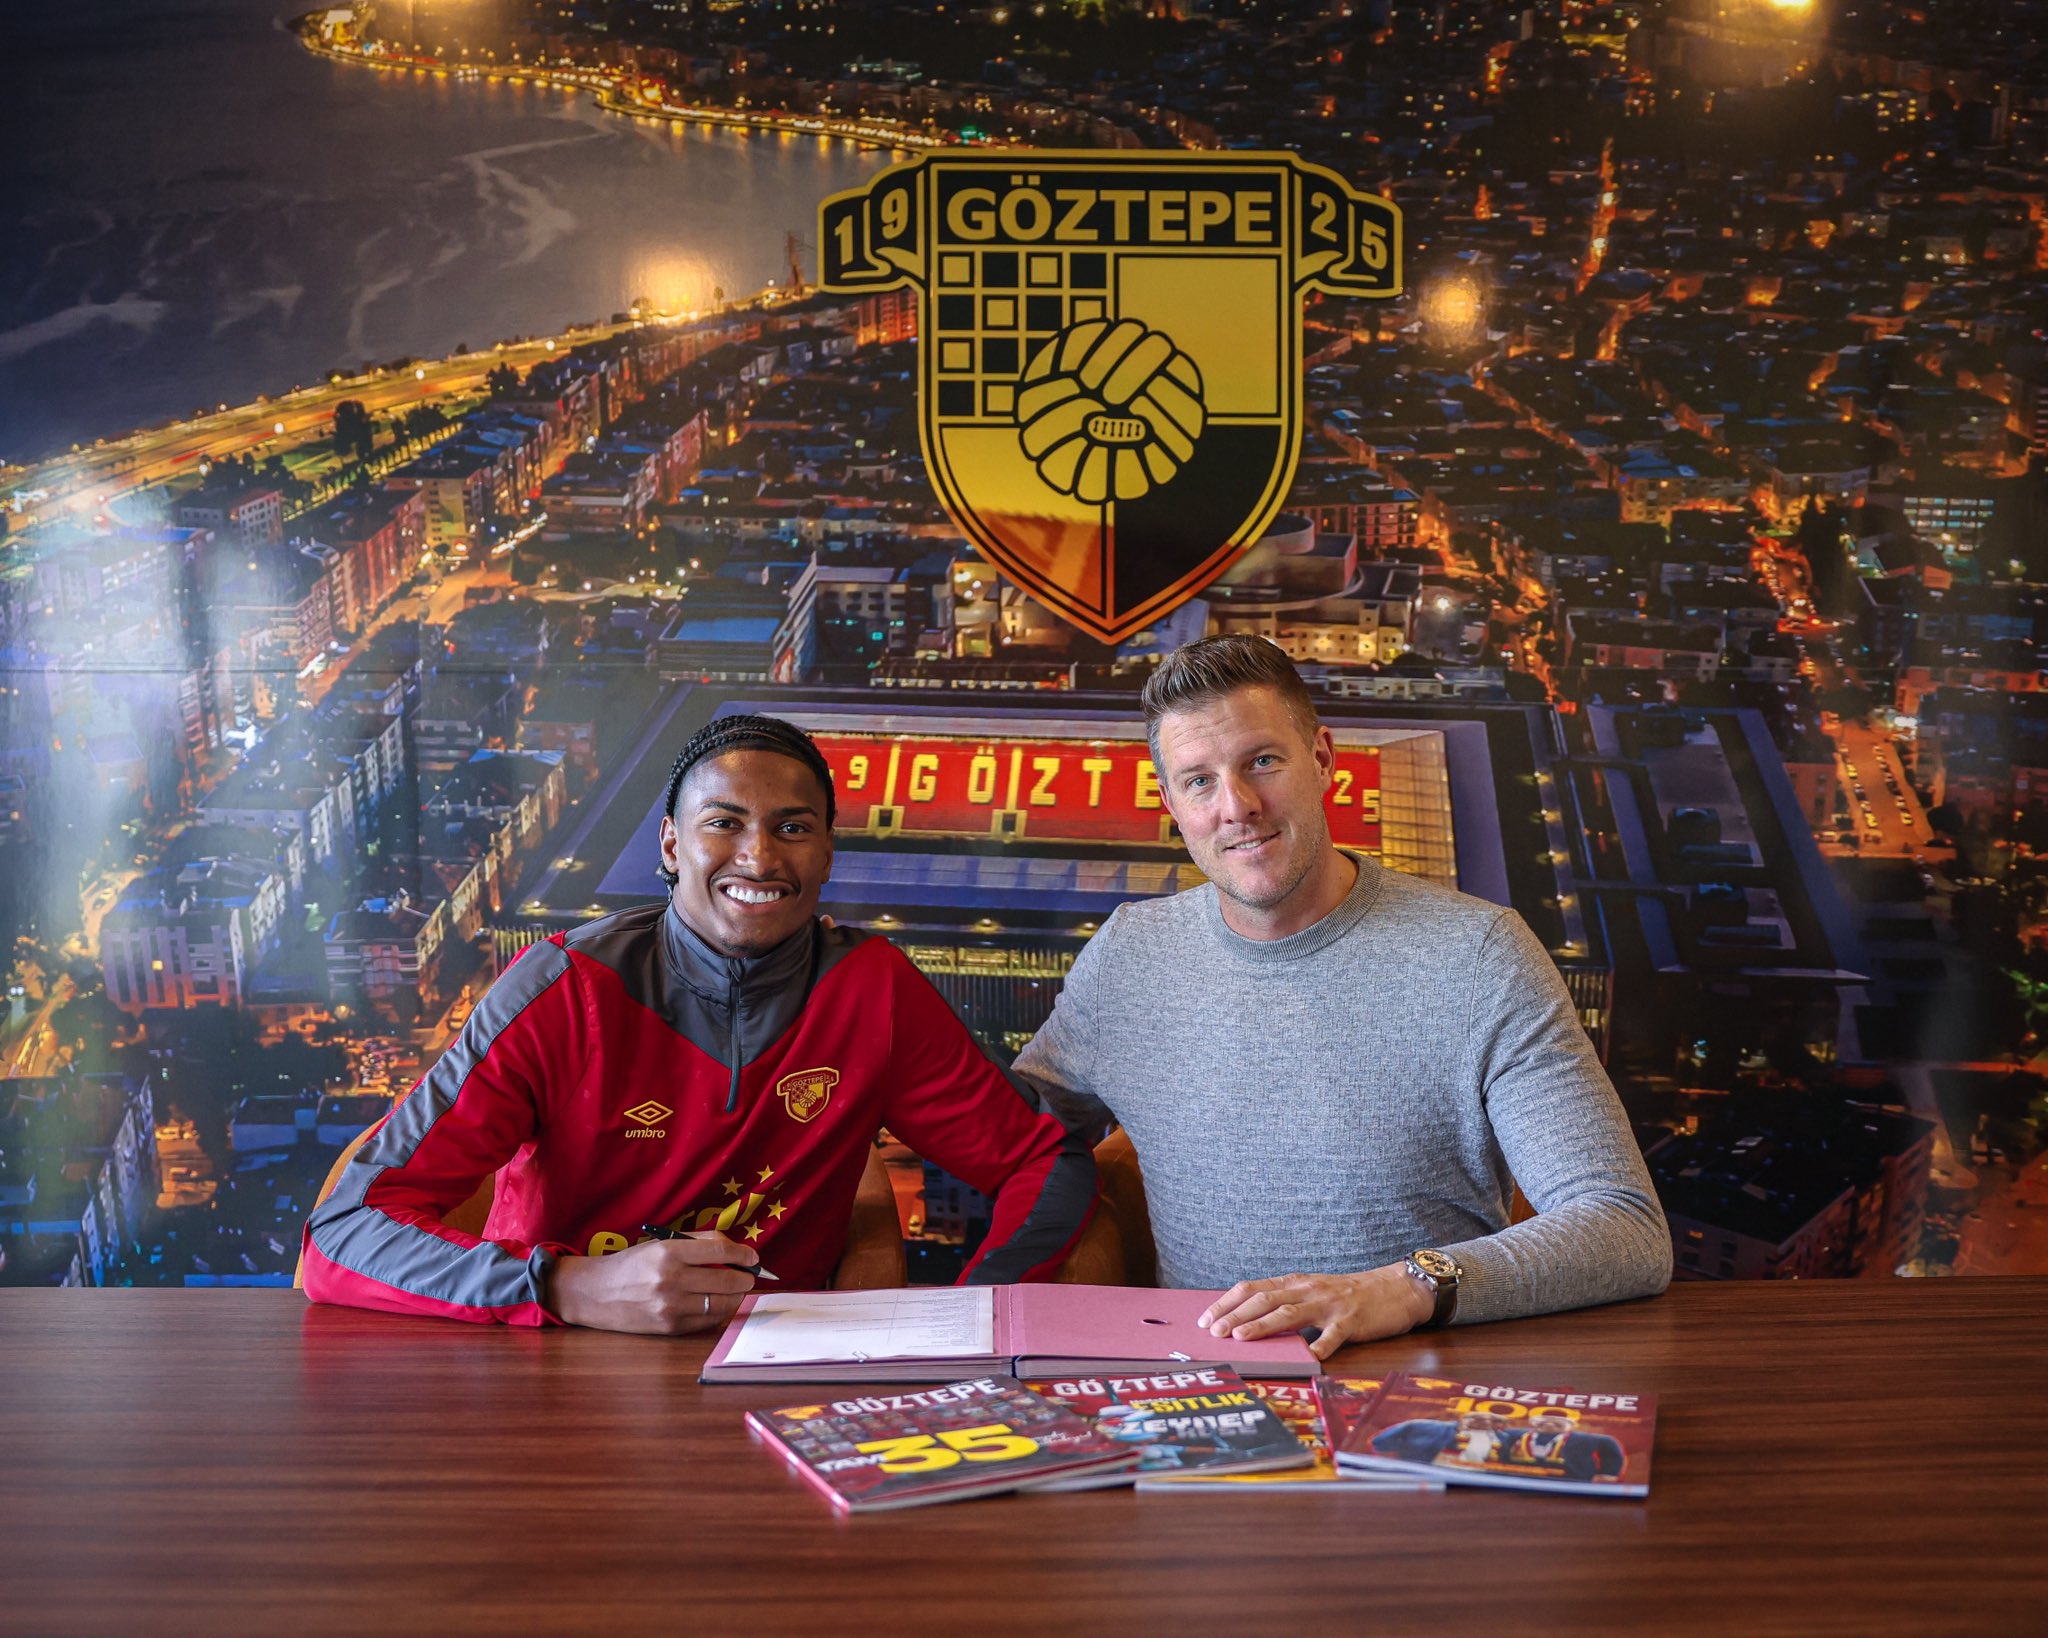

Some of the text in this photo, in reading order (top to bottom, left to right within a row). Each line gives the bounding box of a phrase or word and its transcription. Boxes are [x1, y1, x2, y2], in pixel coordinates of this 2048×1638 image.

[946, 175, 1273, 243] GÖZTEPE
[624, 1127, 666, 1139] umbro
[832, 1379, 1006, 1415] GÖZTEPE
[1053, 1371, 1225, 1397] GÖZTEPE
[1463, 1384, 1639, 1412] GÖZTEPE
[855, 1423, 1040, 1474] 35
